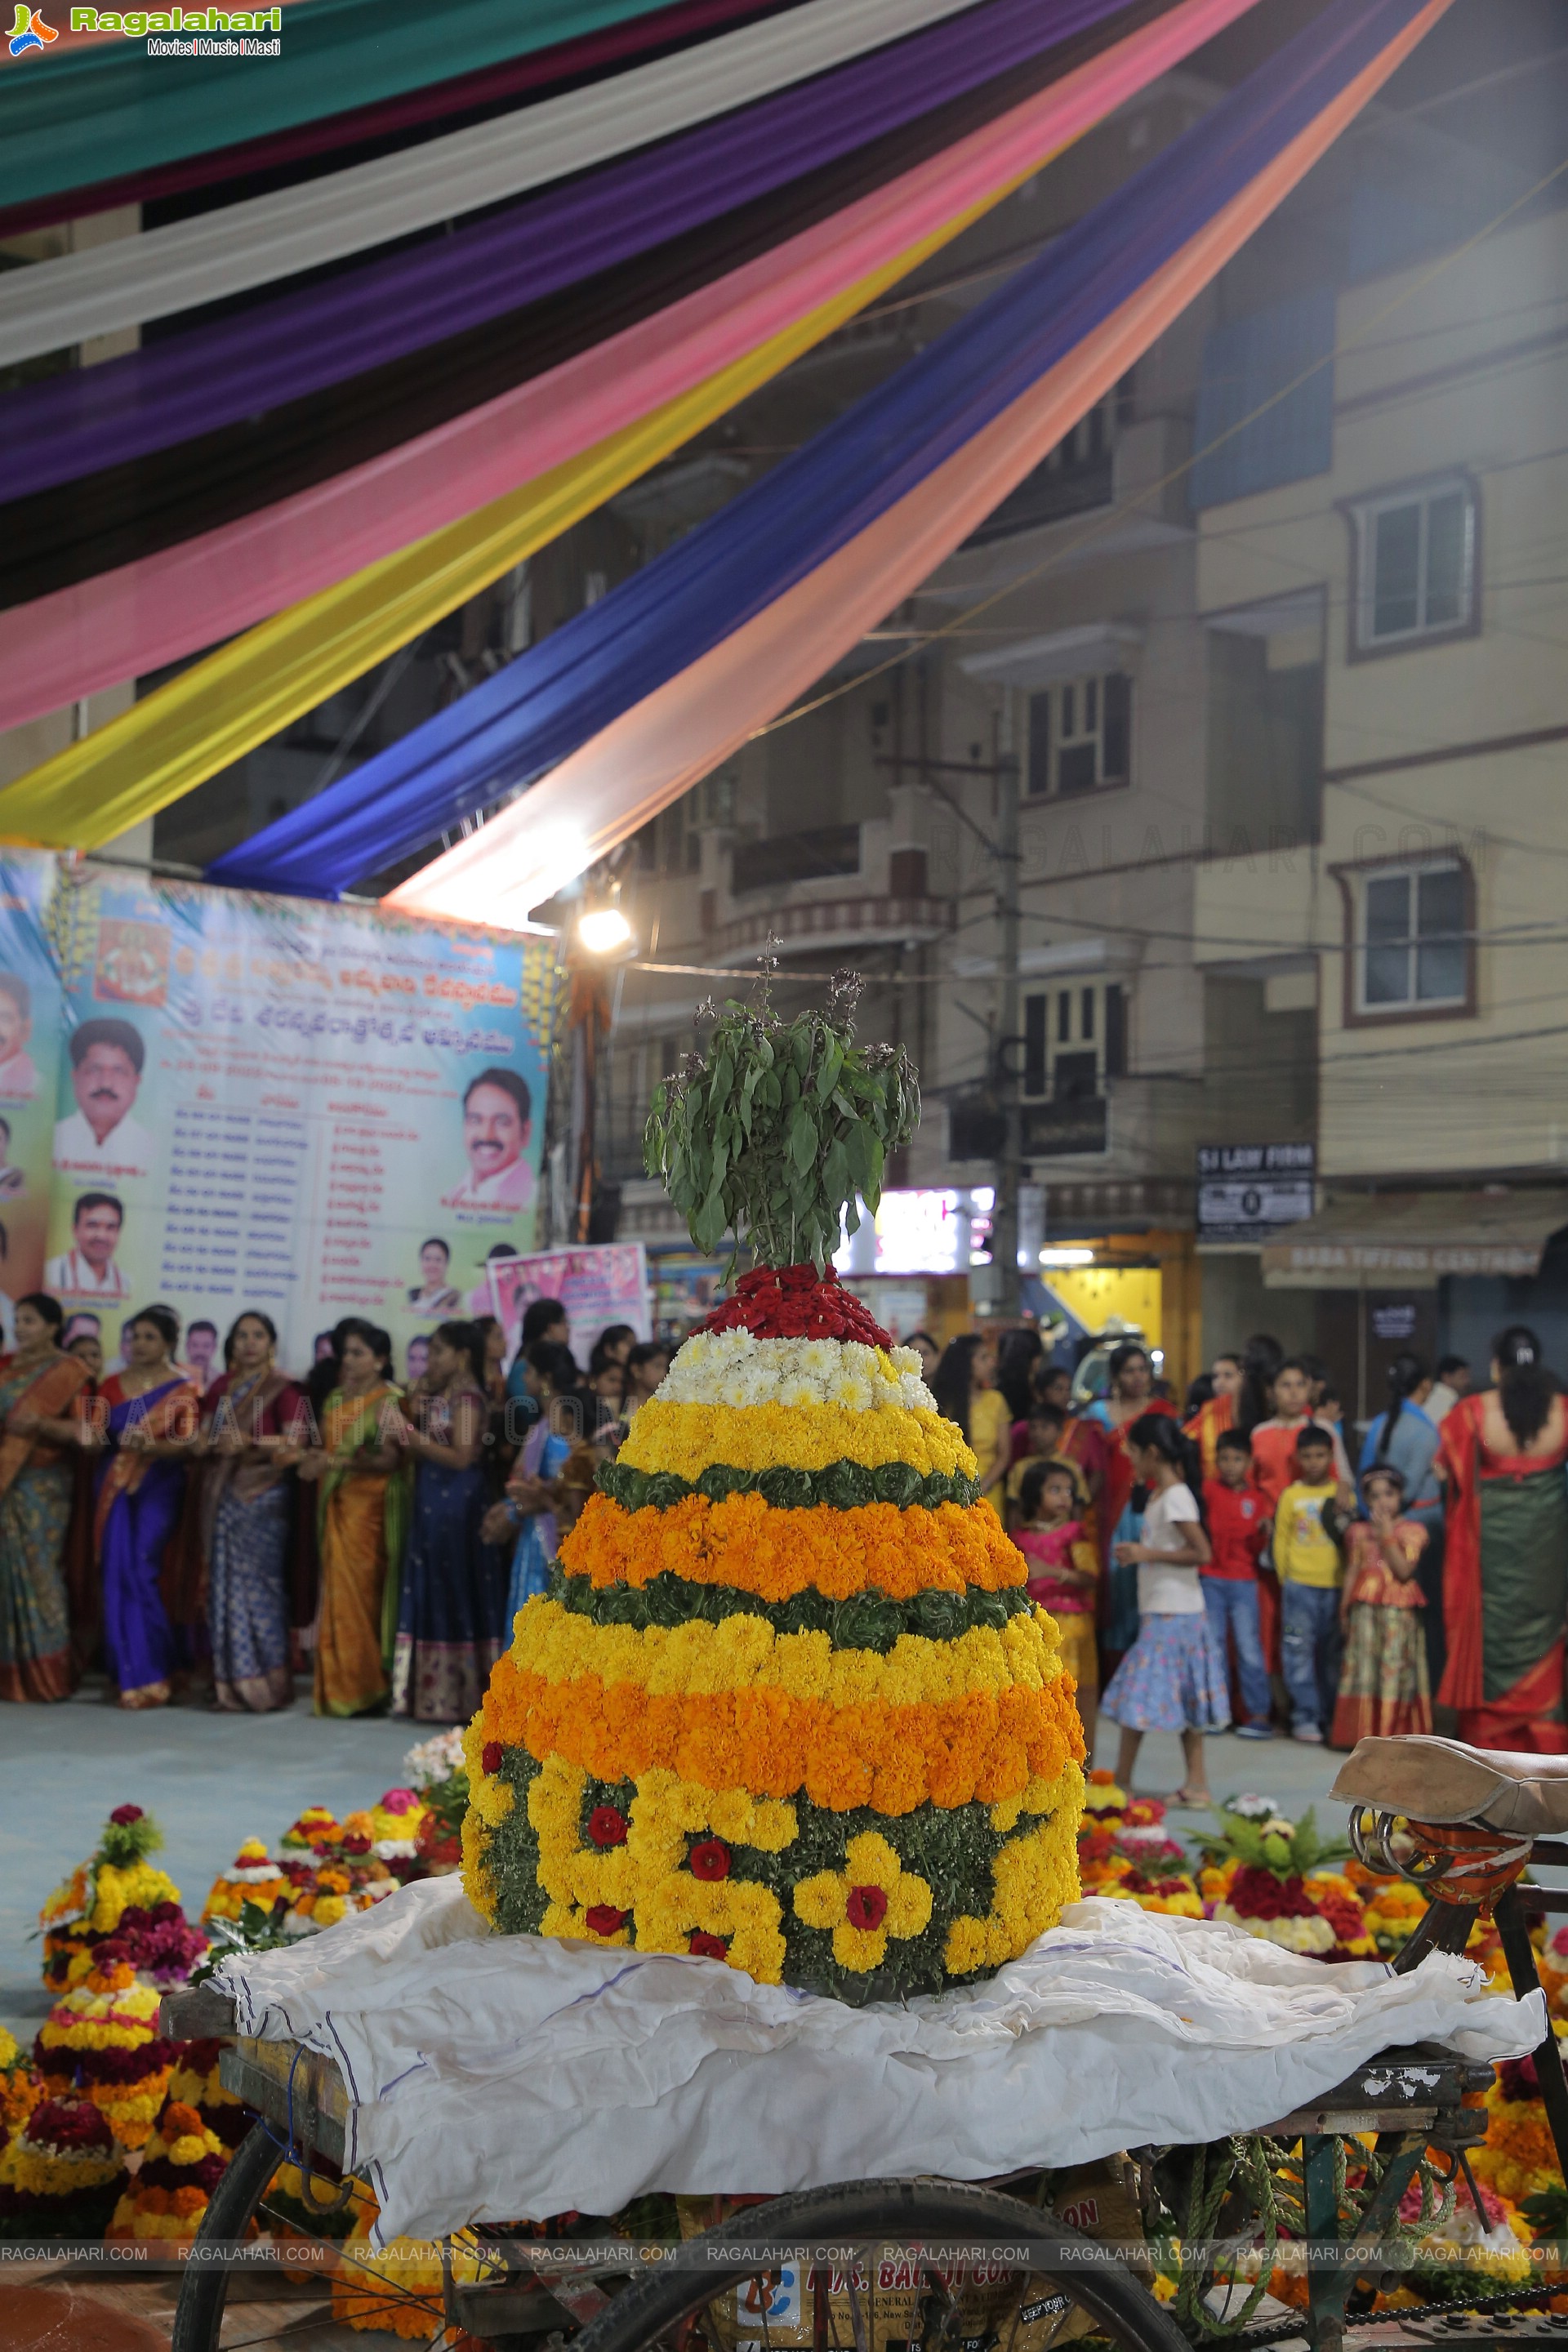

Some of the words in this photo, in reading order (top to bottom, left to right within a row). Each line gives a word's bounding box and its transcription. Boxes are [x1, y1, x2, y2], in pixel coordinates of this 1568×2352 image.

[1221, 1147, 1263, 1170] LAW
[1266, 1144, 1312, 1168] FIRM
[1022, 2305, 1041, 2319] KEEP
[1042, 2296, 1065, 2313] YOUR
